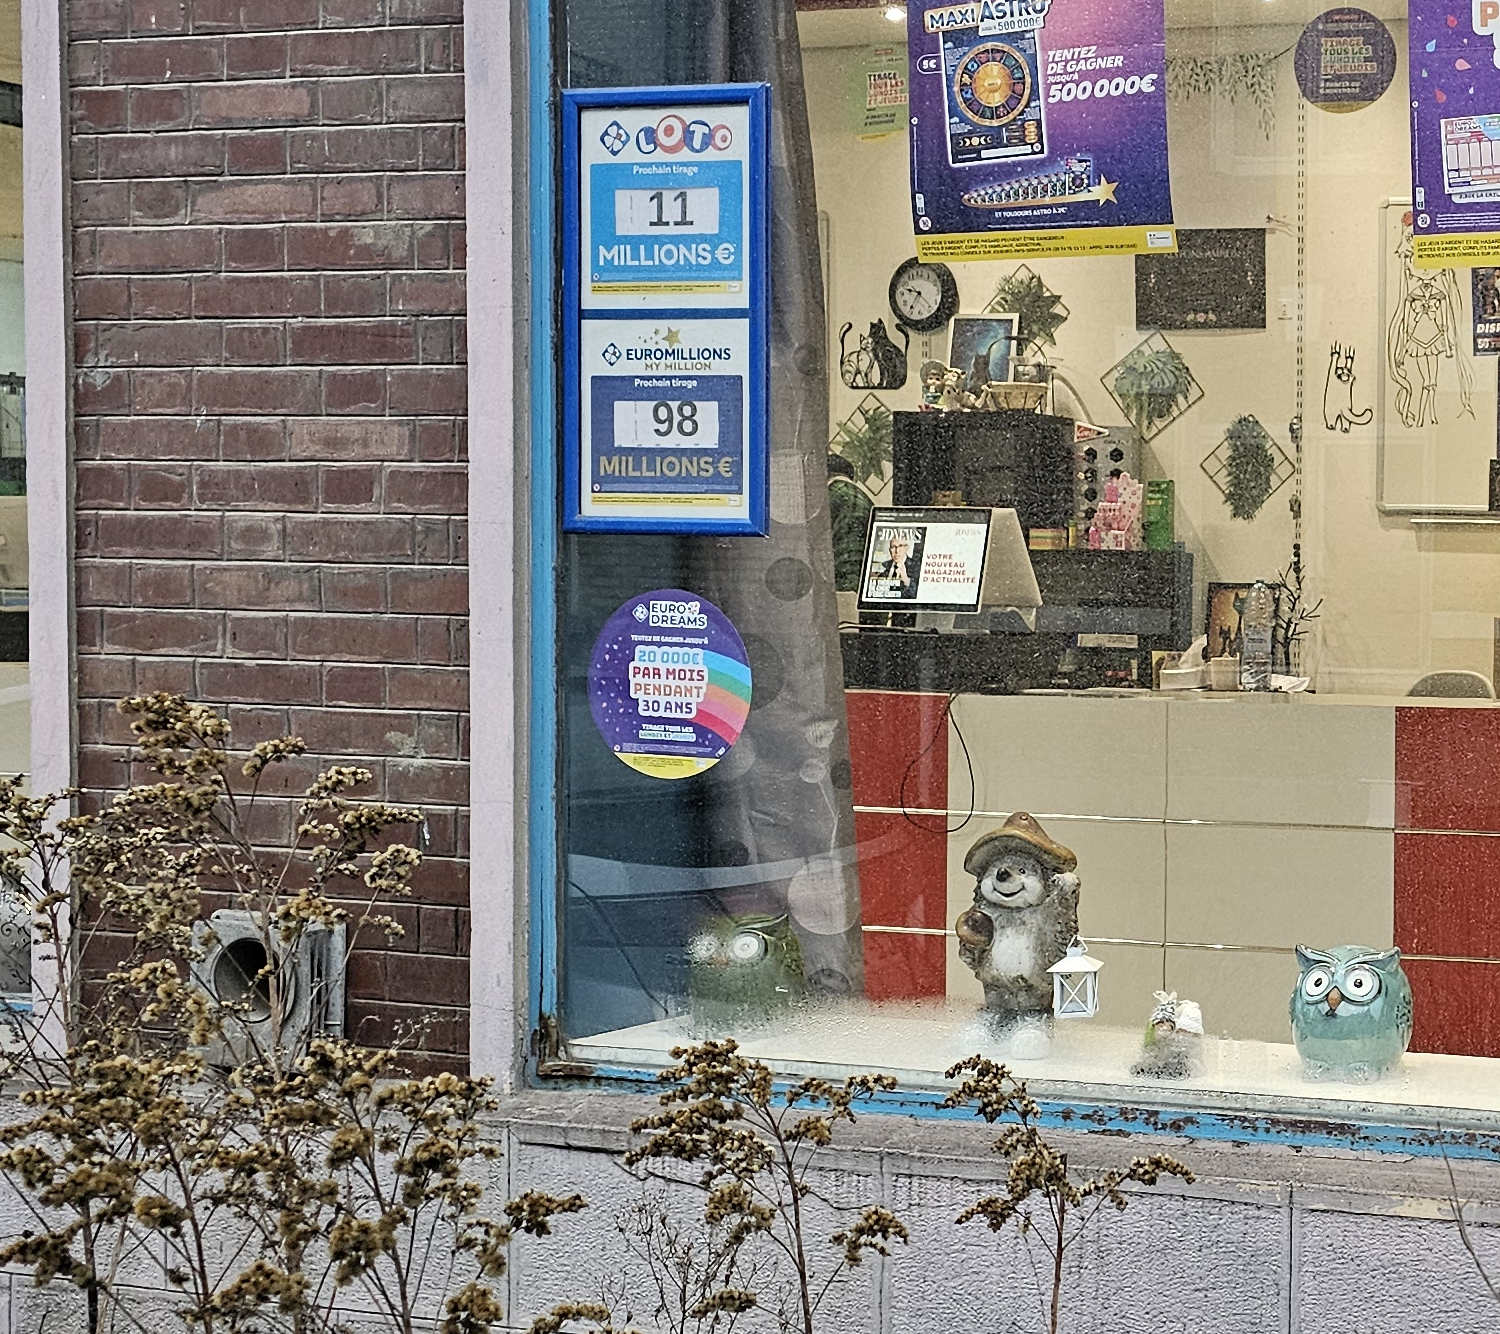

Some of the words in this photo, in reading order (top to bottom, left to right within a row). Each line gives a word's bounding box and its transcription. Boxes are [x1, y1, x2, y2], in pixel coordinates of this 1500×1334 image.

[930, 8, 977, 29] MAXI
[998, 19, 1014, 31] 500
[1324, 38, 1362, 47] TIRAGE
[1048, 46, 1097, 61] TENTEZ
[1352, 47, 1371, 55] LES
[1047, 63, 1064, 73] DE
[1066, 56, 1123, 72] GAGNER
[1048, 83, 1091, 103] 500
[1093, 74, 1158, 99] 000€
[636, 115, 732, 154] LOTO
[633, 165, 672, 174] Prochain
[673, 165, 698, 176] tirage
[649, 191, 694, 227] 11
[599, 244, 711, 266] MILLIONS
[715, 243, 735, 264] €
[627, 348, 731, 360] EUROMILLIONS
[645, 362, 659, 370] MY
[665, 362, 711, 370] MILLION
[634, 379, 670, 387] Prochain
[672, 379, 697, 389] tirage
[652, 401, 699, 436] 98
[600, 456, 713, 477] MILLIONS
[718, 457, 733, 477] €
[652, 603, 686, 613] EURO
[652, 615, 705, 626] DREAMS
[639, 651, 655, 662] 20
[661, 651, 700, 664] 000€
[633, 667, 661, 679] PAR
[666, 668, 704, 681] MOIS
[634, 683, 703, 698] PENDANT
[643, 700, 659, 712] 30
[663, 702, 693, 714] ANS
